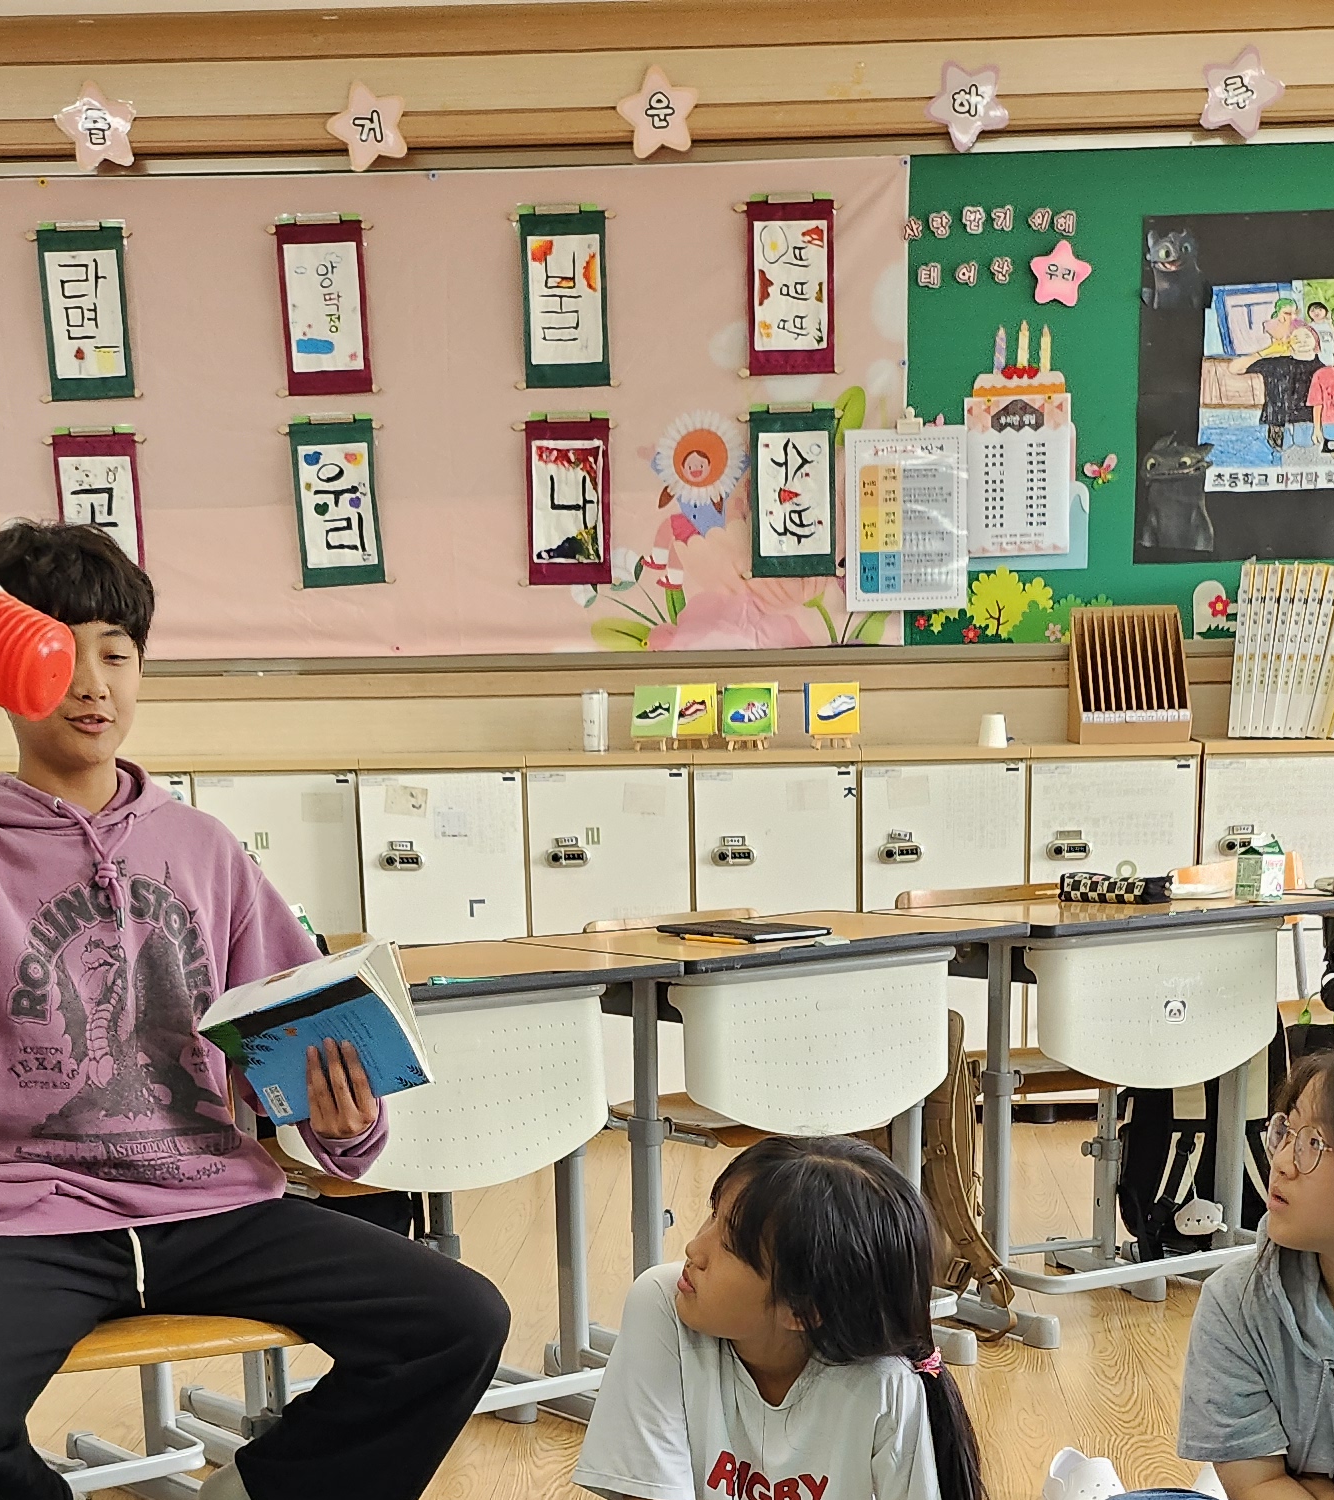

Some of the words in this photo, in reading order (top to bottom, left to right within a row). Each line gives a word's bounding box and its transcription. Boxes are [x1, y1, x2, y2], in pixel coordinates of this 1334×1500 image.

[351, 108, 383, 144] 거
[645, 91, 675, 130] 운
[951, 83, 984, 118] 하
[1028, 207, 1077, 237] 위해
[918, 256, 1013, 288] 태어난
[1045, 263, 1077, 282] 우리
[57, 258, 108, 341] 라면
[1212, 471, 1270, 489] 초등학교
[1276, 471, 1320, 489] 마지막
[313, 462, 368, 553] 우리
[19, 1046, 64, 1056] HOUSTON
[6, 1056, 80, 1081] TEXAS
